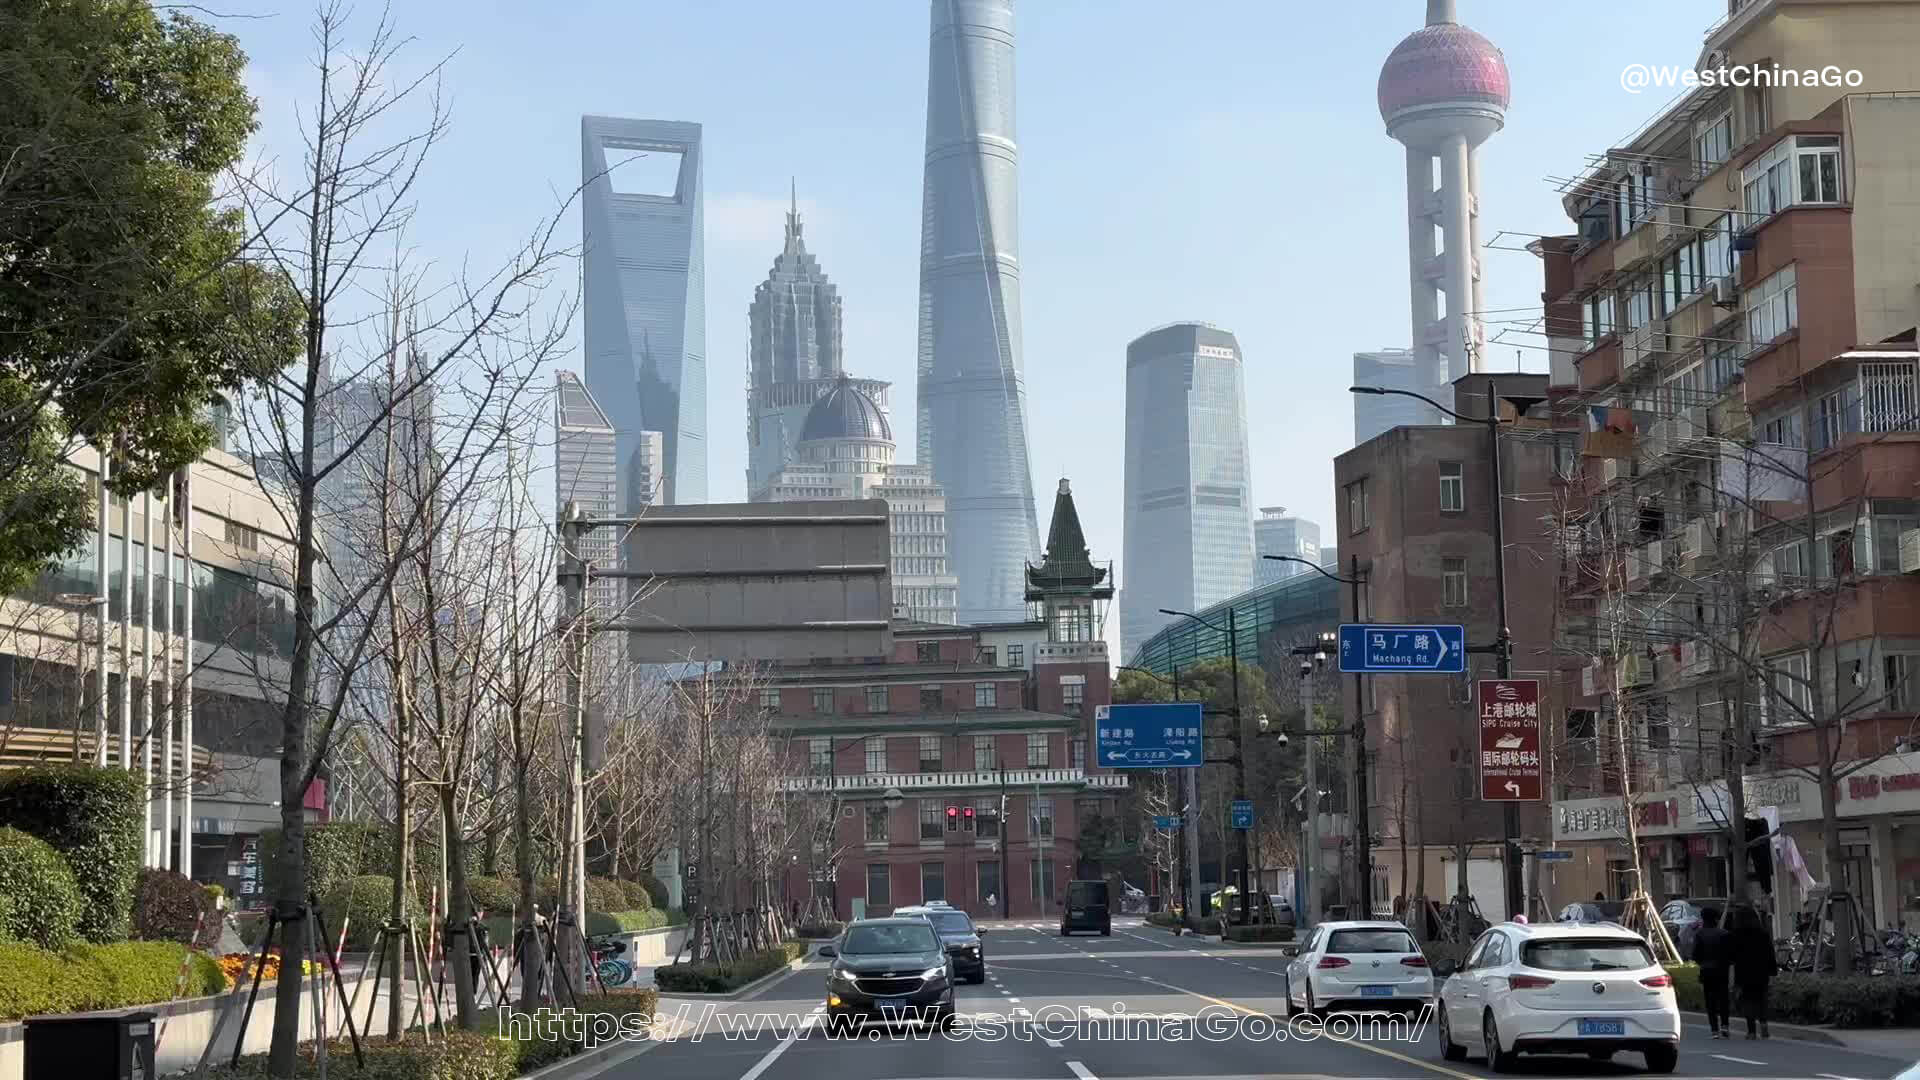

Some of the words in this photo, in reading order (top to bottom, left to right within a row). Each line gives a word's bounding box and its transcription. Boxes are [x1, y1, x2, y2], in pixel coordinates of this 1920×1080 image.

[1372, 634, 1429, 650] 马厂路
[1373, 654, 1411, 664] Machang
[1481, 702, 1537, 718] 上港邮轮城
[1500, 720, 1520, 728] Cruise
[1523, 720, 1537, 728] City
[1482, 751, 1538, 766] 国际邮轮码头
